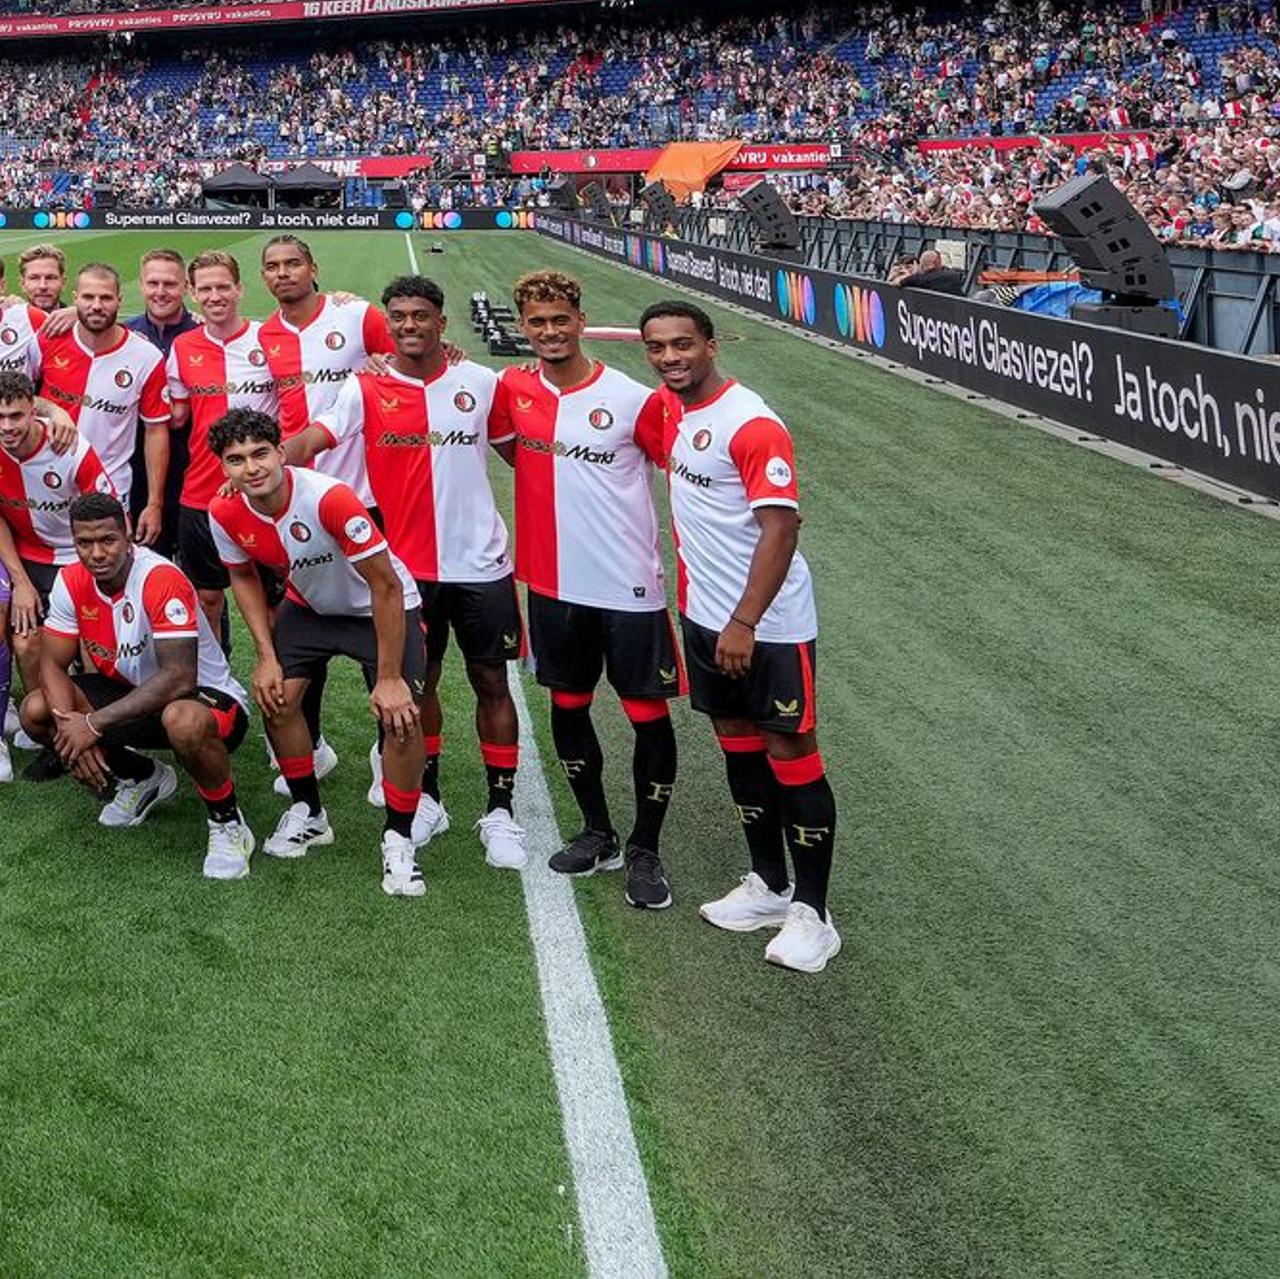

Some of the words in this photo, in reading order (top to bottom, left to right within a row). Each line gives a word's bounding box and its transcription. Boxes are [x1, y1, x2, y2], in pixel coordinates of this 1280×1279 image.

[303, 1, 319, 17] 16
[321, 0, 361, 16] KEER
[105, 212, 174, 228] Supersnel
[176, 212, 251, 226] Glasvezel?
[259, 213, 276, 227] Ja
[277, 212, 313, 228] toch,
[316, 212, 344, 227] niet
[347, 212, 379, 226] dan!
[897, 299, 978, 367] Supersnel
[979, 318, 1095, 403] Glasvezel?
[1114, 354, 1143, 423] Ja
[1145, 365, 1231, 458] toch,
[565, 444, 615, 465] Markt
[675, 462, 712, 488] Markt
[291, 553, 334, 571] Markt
[792, 823, 829, 847] F
